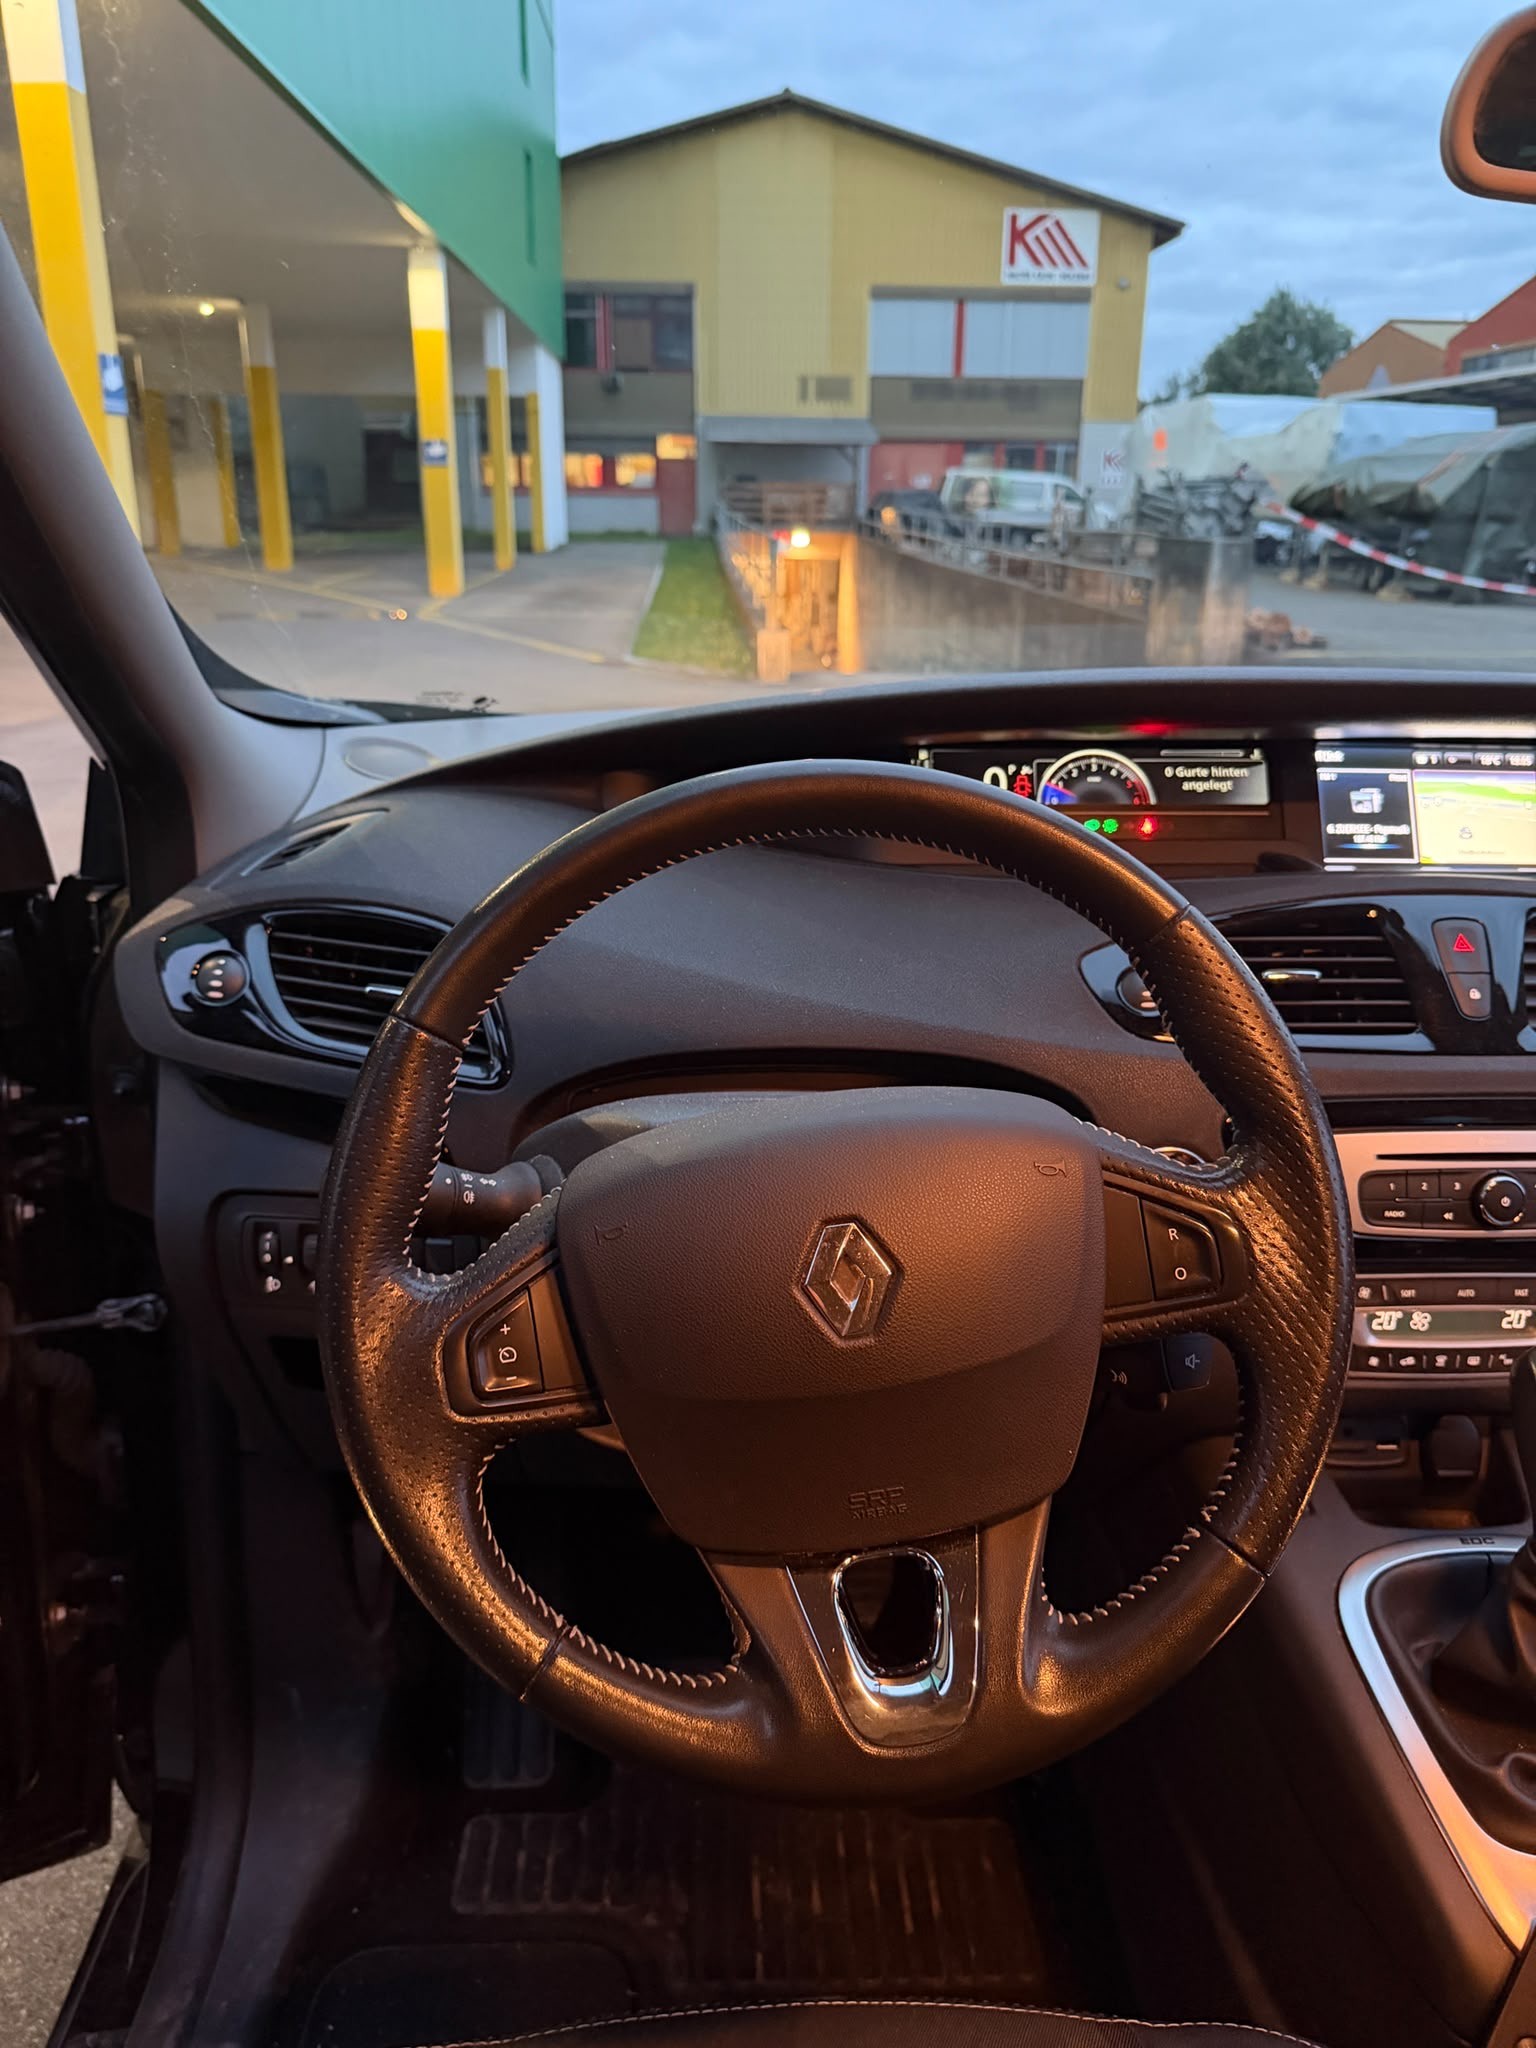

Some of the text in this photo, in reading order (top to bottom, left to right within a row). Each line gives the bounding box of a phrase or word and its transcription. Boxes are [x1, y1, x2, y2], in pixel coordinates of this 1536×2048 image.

[1175, 766, 1210, 778] Gurte
[1211, 766, 1249, 778] hinten
[1182, 779, 1233, 793] angelegt
[1388, 1182, 1396, 1191] 1
[1421, 1182, 1428, 1191] 2
[1454, 1182, 1461, 1191] 3
[1384, 1210, 1407, 1218] RADIO
[1168, 1228, 1179, 1241] R
[1400, 1289, 1416, 1297] SOFT
[1457, 1289, 1476, 1297] AUTO
[1514, 1289, 1529, 1297] FAST
[1459, 1536, 1495, 1545] EDC
